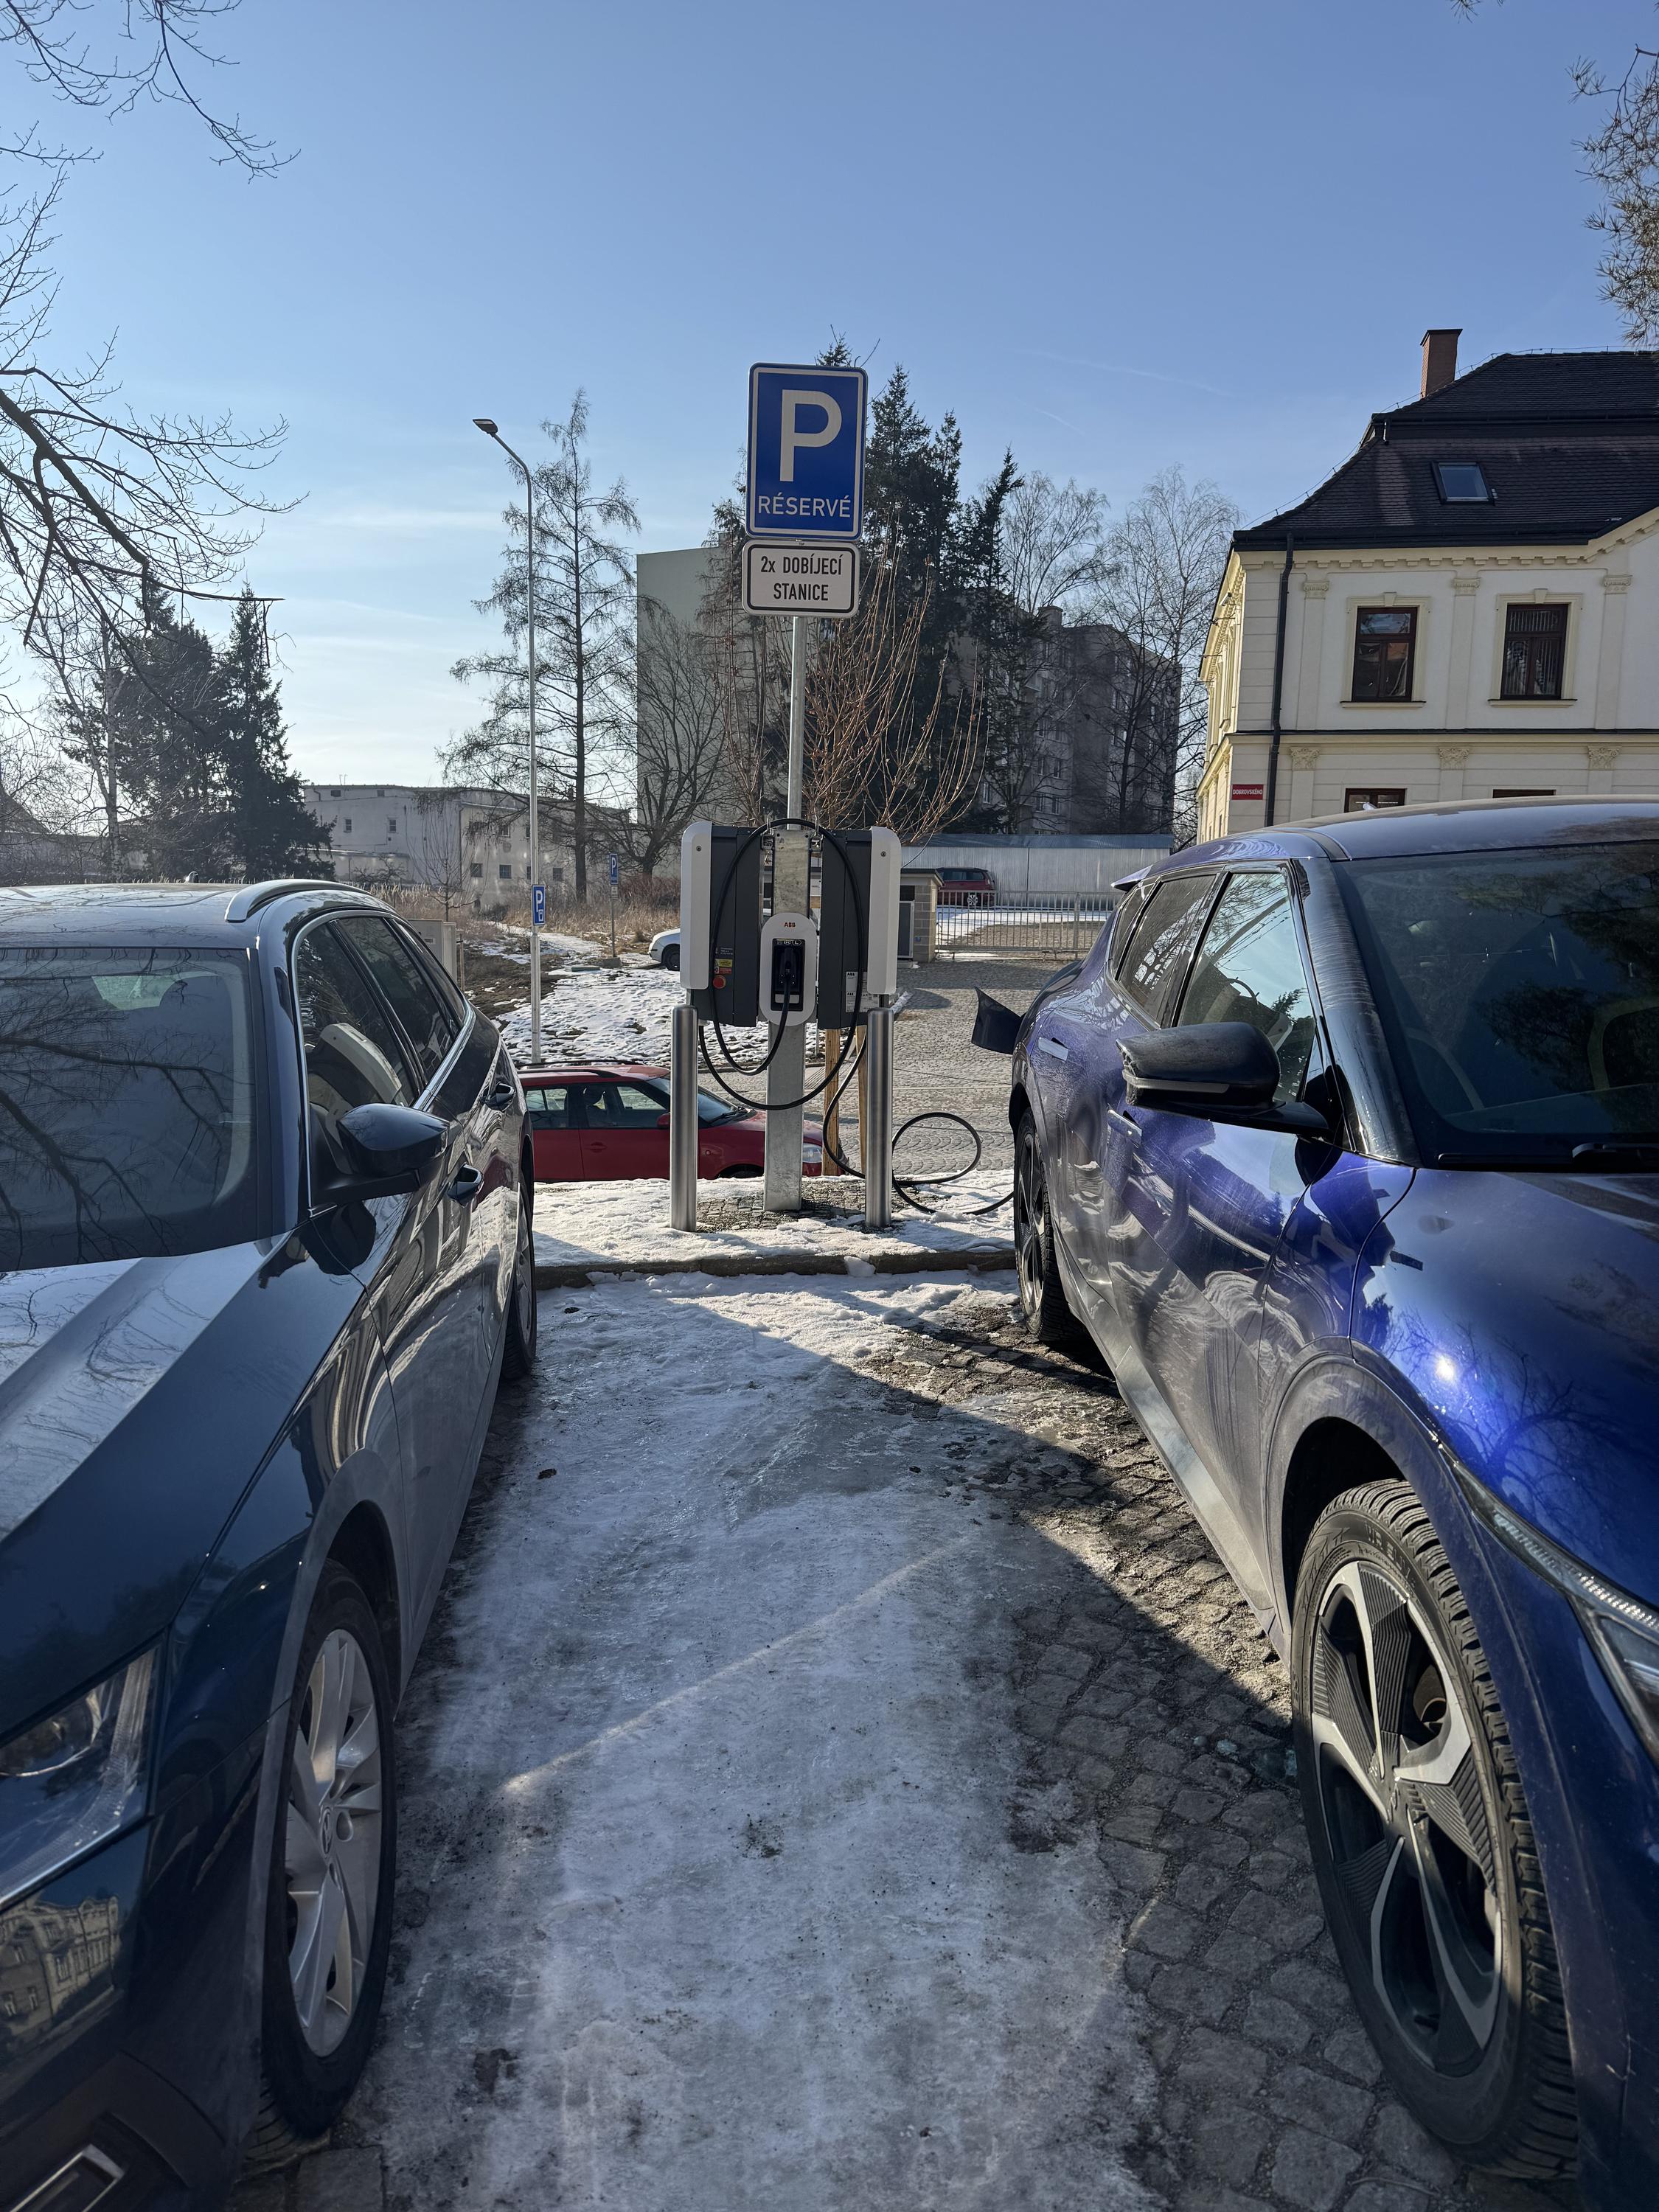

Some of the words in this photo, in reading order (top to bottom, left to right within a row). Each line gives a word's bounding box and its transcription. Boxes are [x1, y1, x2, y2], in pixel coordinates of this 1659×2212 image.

[779, 389, 842, 482] P
[758, 492, 851, 518] RÉSERVÉ
[760, 555, 776, 573] 2x
[782, 553, 844, 575] DOBÍJECÍ
[773, 582, 829, 601] STANICE
[612, 857, 616, 874] P
[536, 890, 543, 912] P
